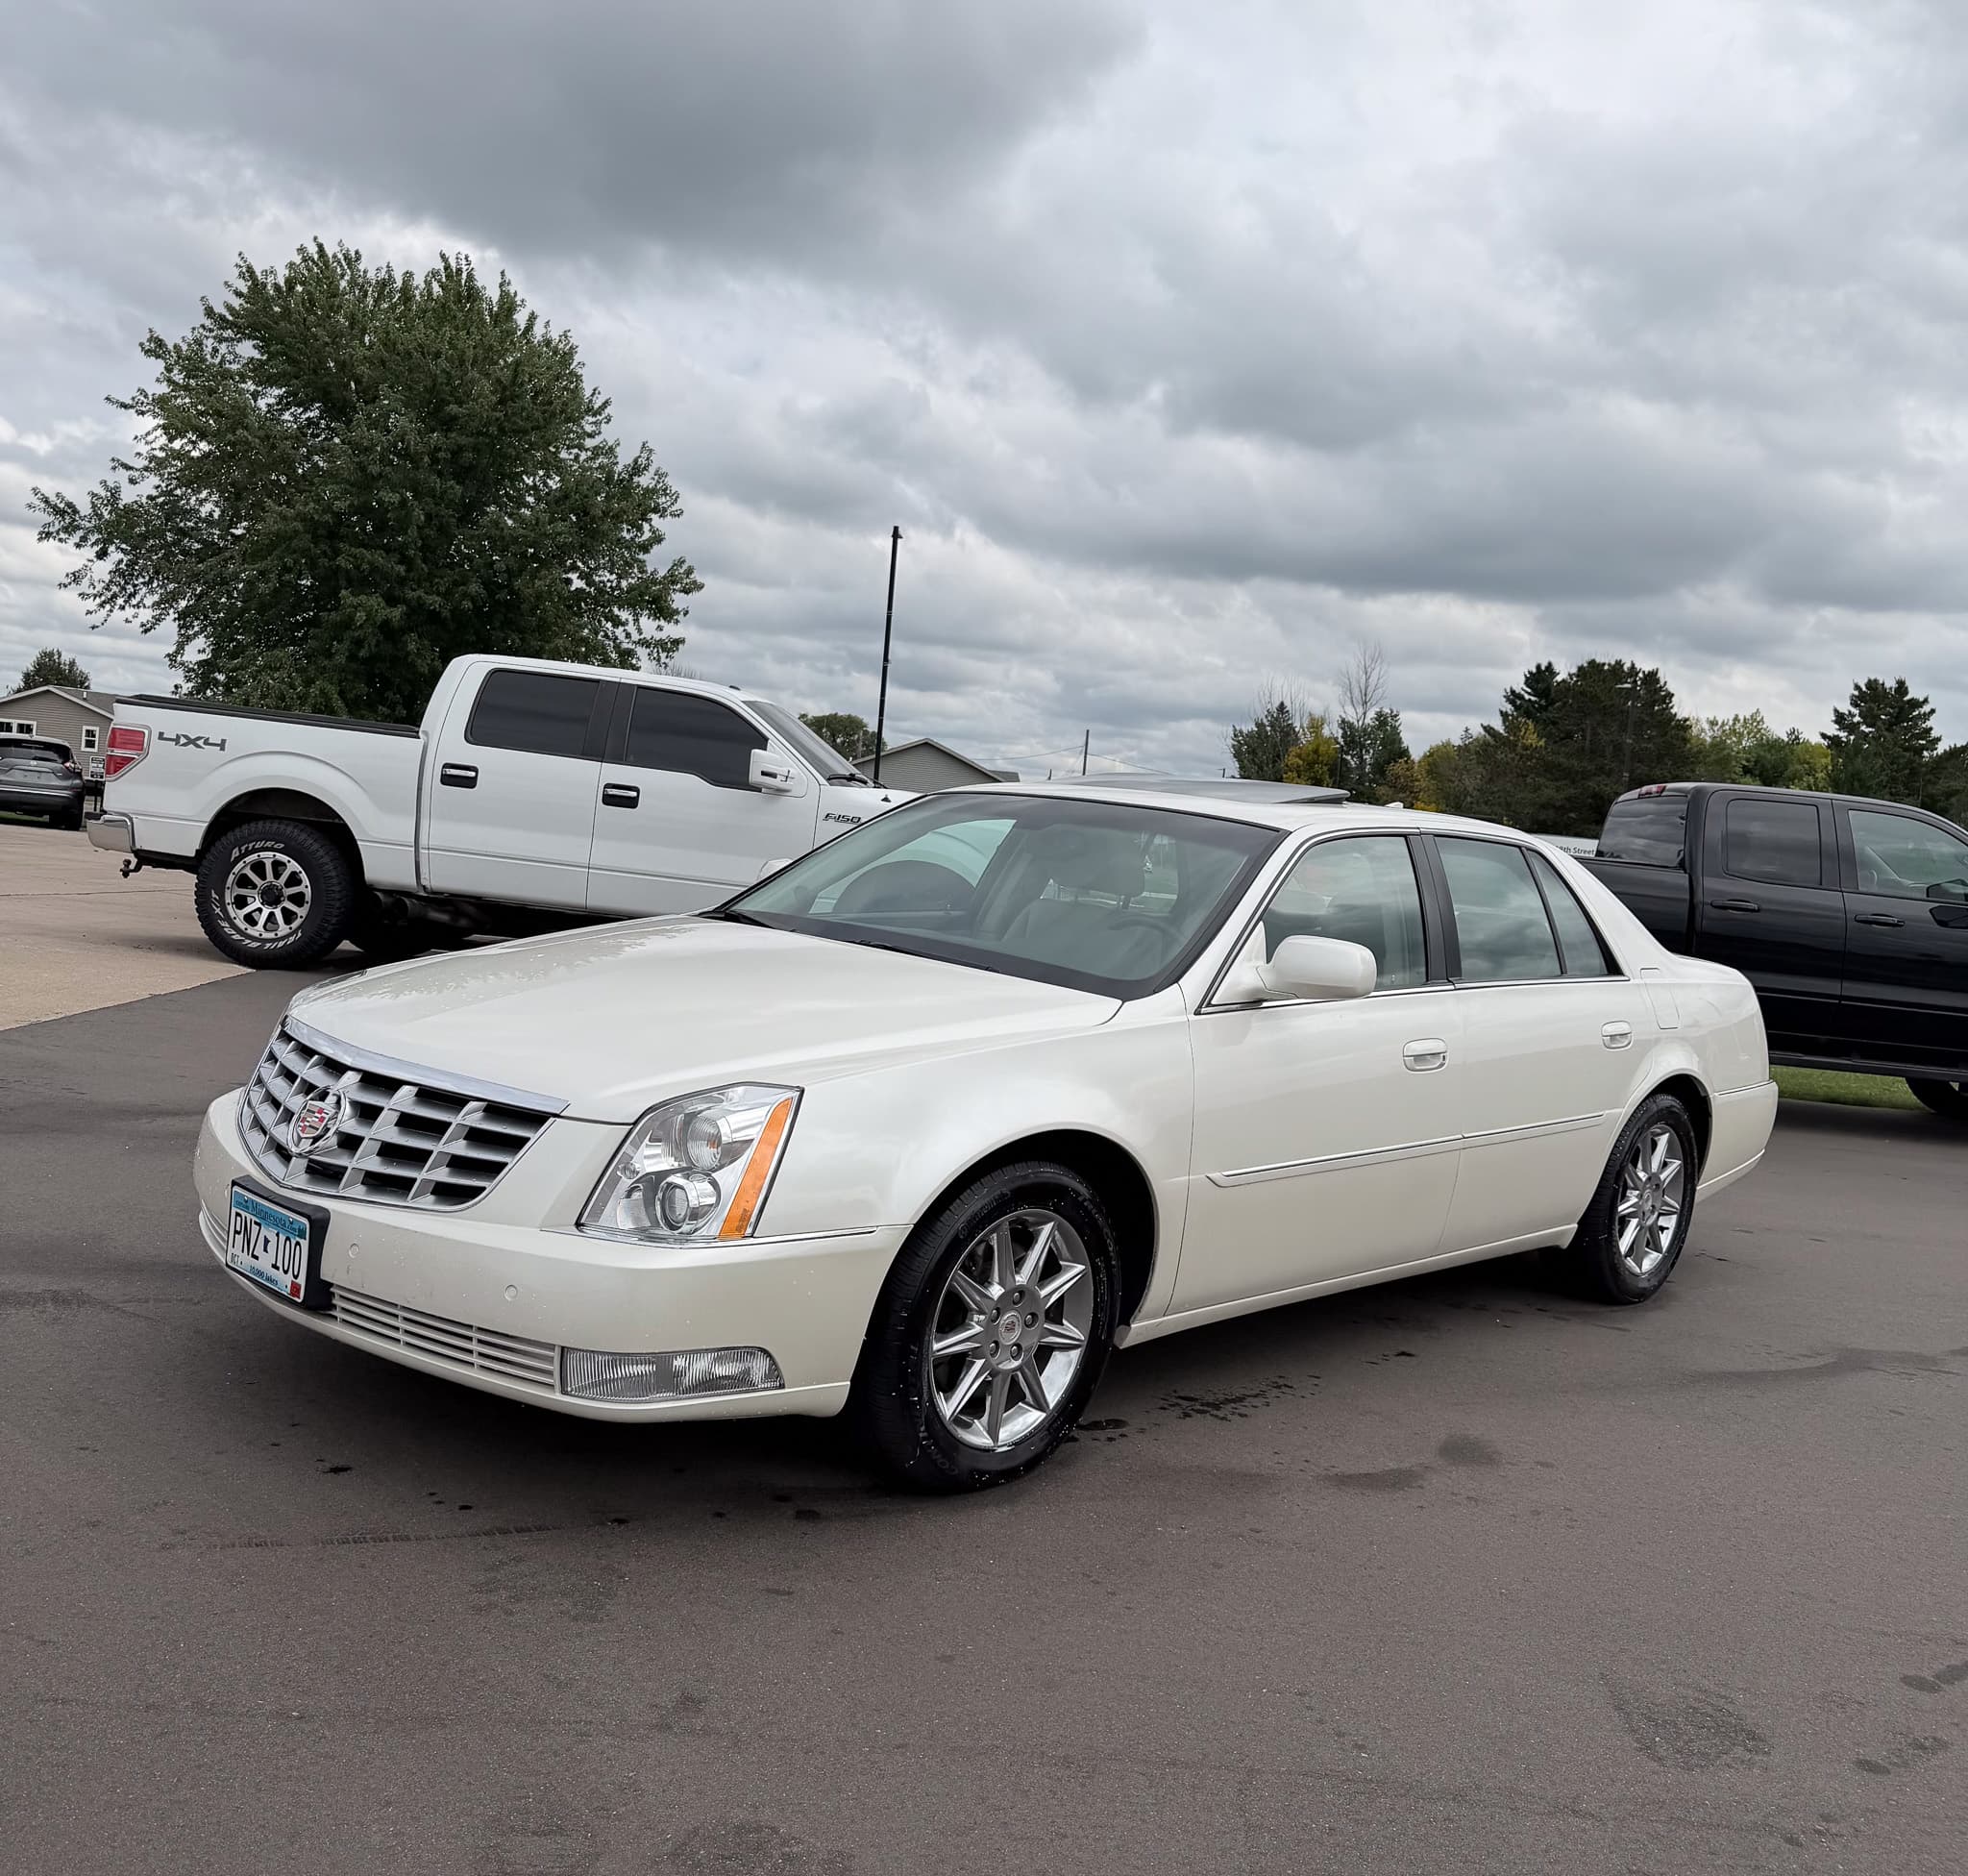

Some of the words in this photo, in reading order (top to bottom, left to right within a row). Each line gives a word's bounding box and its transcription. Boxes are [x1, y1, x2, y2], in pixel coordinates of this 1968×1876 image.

[1573, 847, 1595, 855] Street
[263, 928, 303, 950] TRAIL
[251, 1198, 286, 1227] Minnesota
[232, 1211, 262, 1261] PNZ
[271, 1231, 303, 1280] 100
